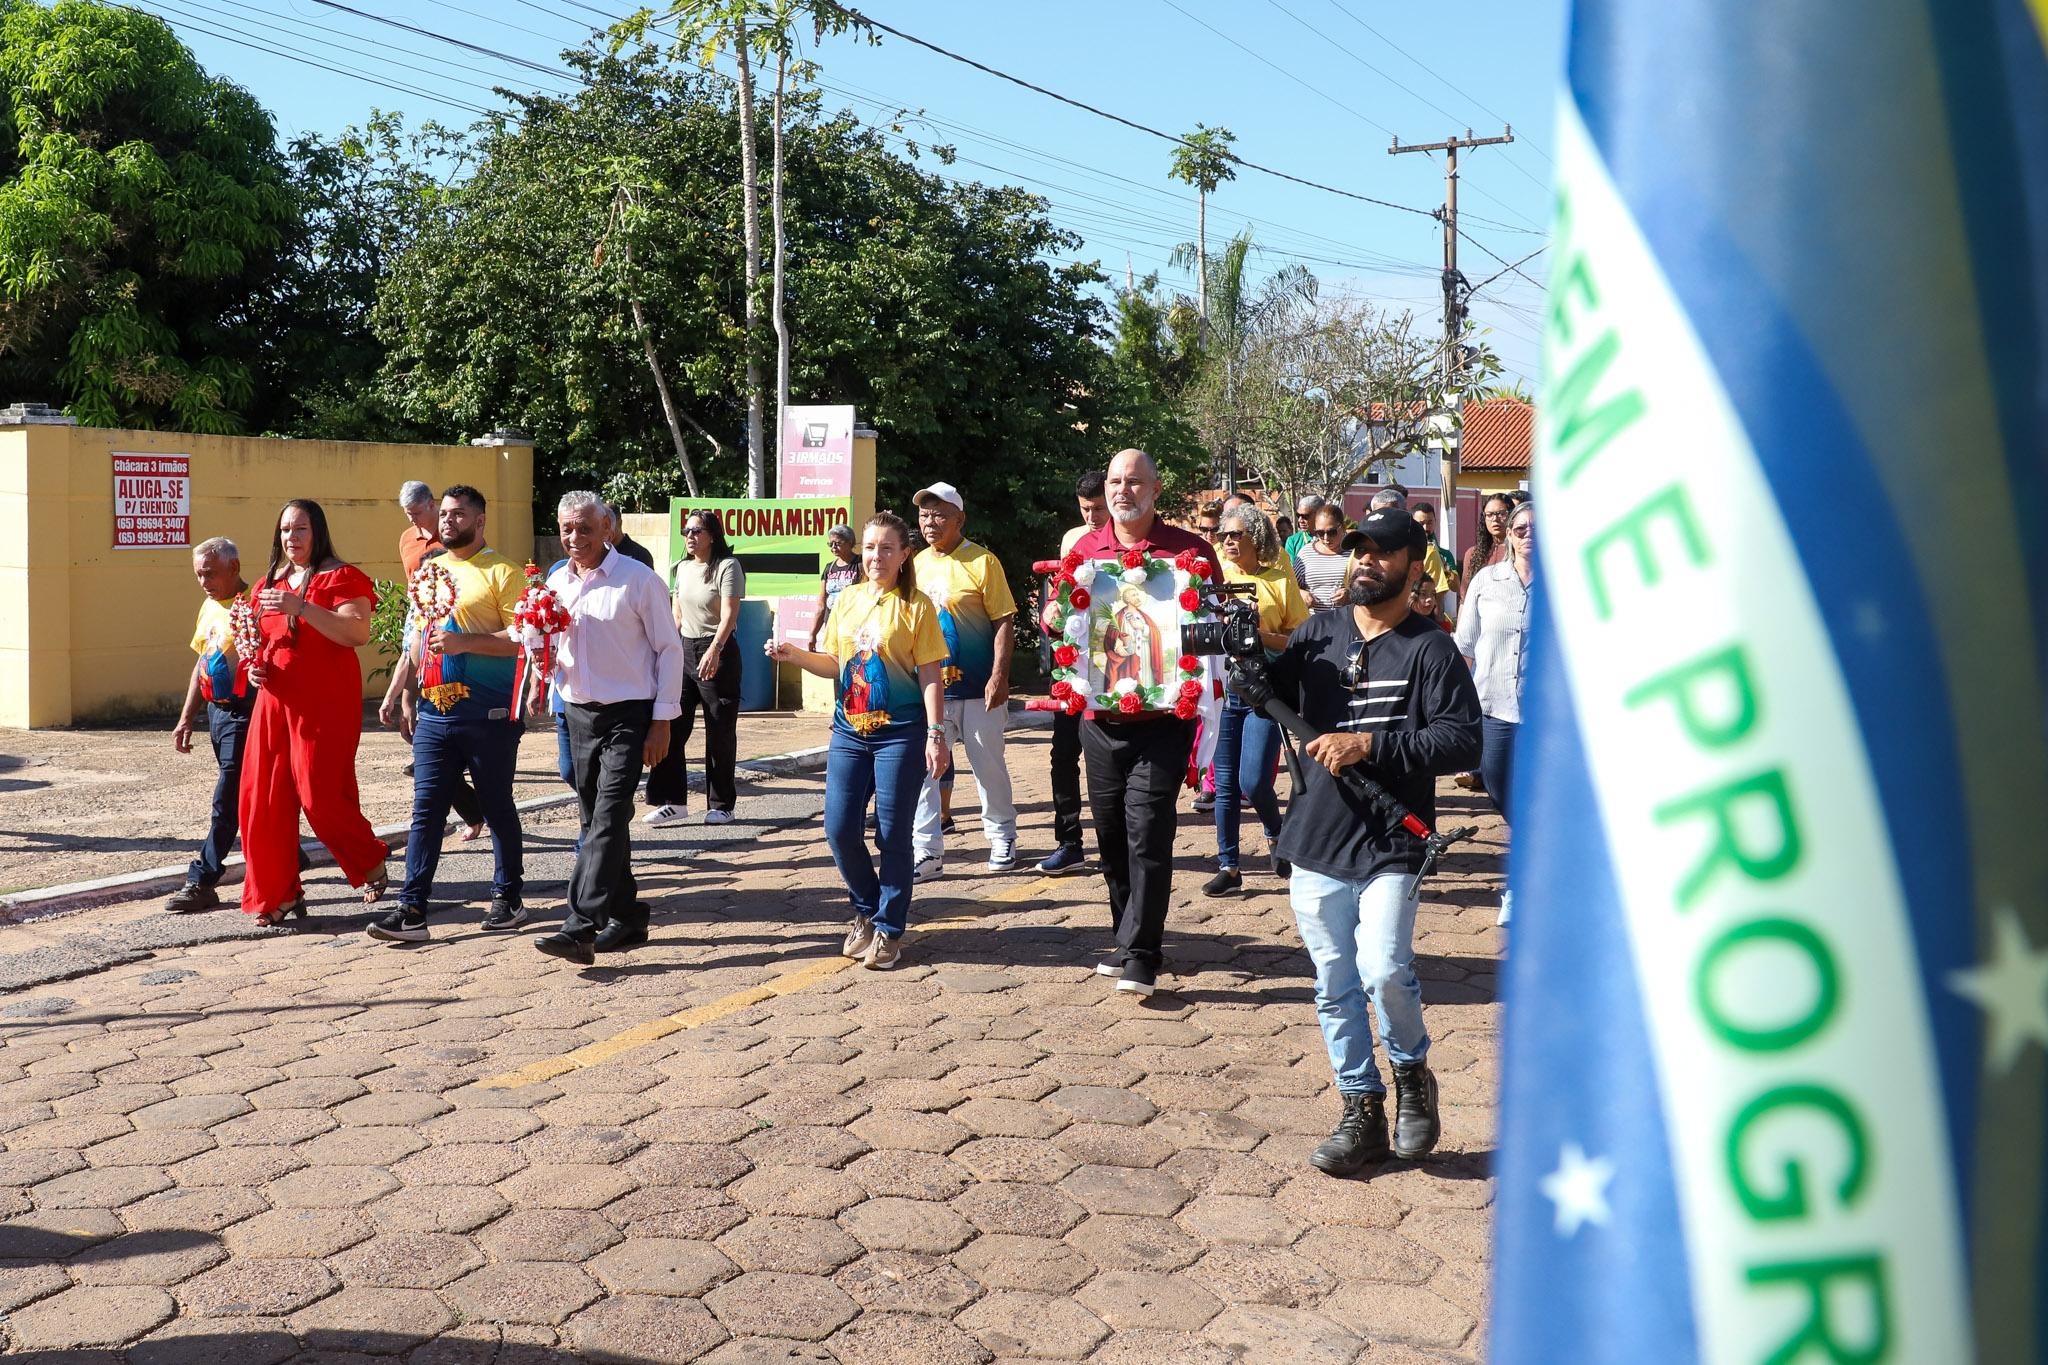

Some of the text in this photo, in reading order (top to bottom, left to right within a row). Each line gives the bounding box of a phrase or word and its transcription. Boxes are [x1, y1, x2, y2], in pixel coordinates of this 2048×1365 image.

[114, 459, 187, 472] Chácara 3 irmãos
[800, 476, 833, 485] Temos
[119, 479, 183, 499] ALUGA-SE
[125, 501, 178, 514] P/ EVENTOS
[117, 518, 186, 529] (65) 99694-3407
[118, 532, 186, 543] (65) 99942-7144
[1581, 481, 1710, 620] E
[1623, 643, 1893, 1365] PROGR
